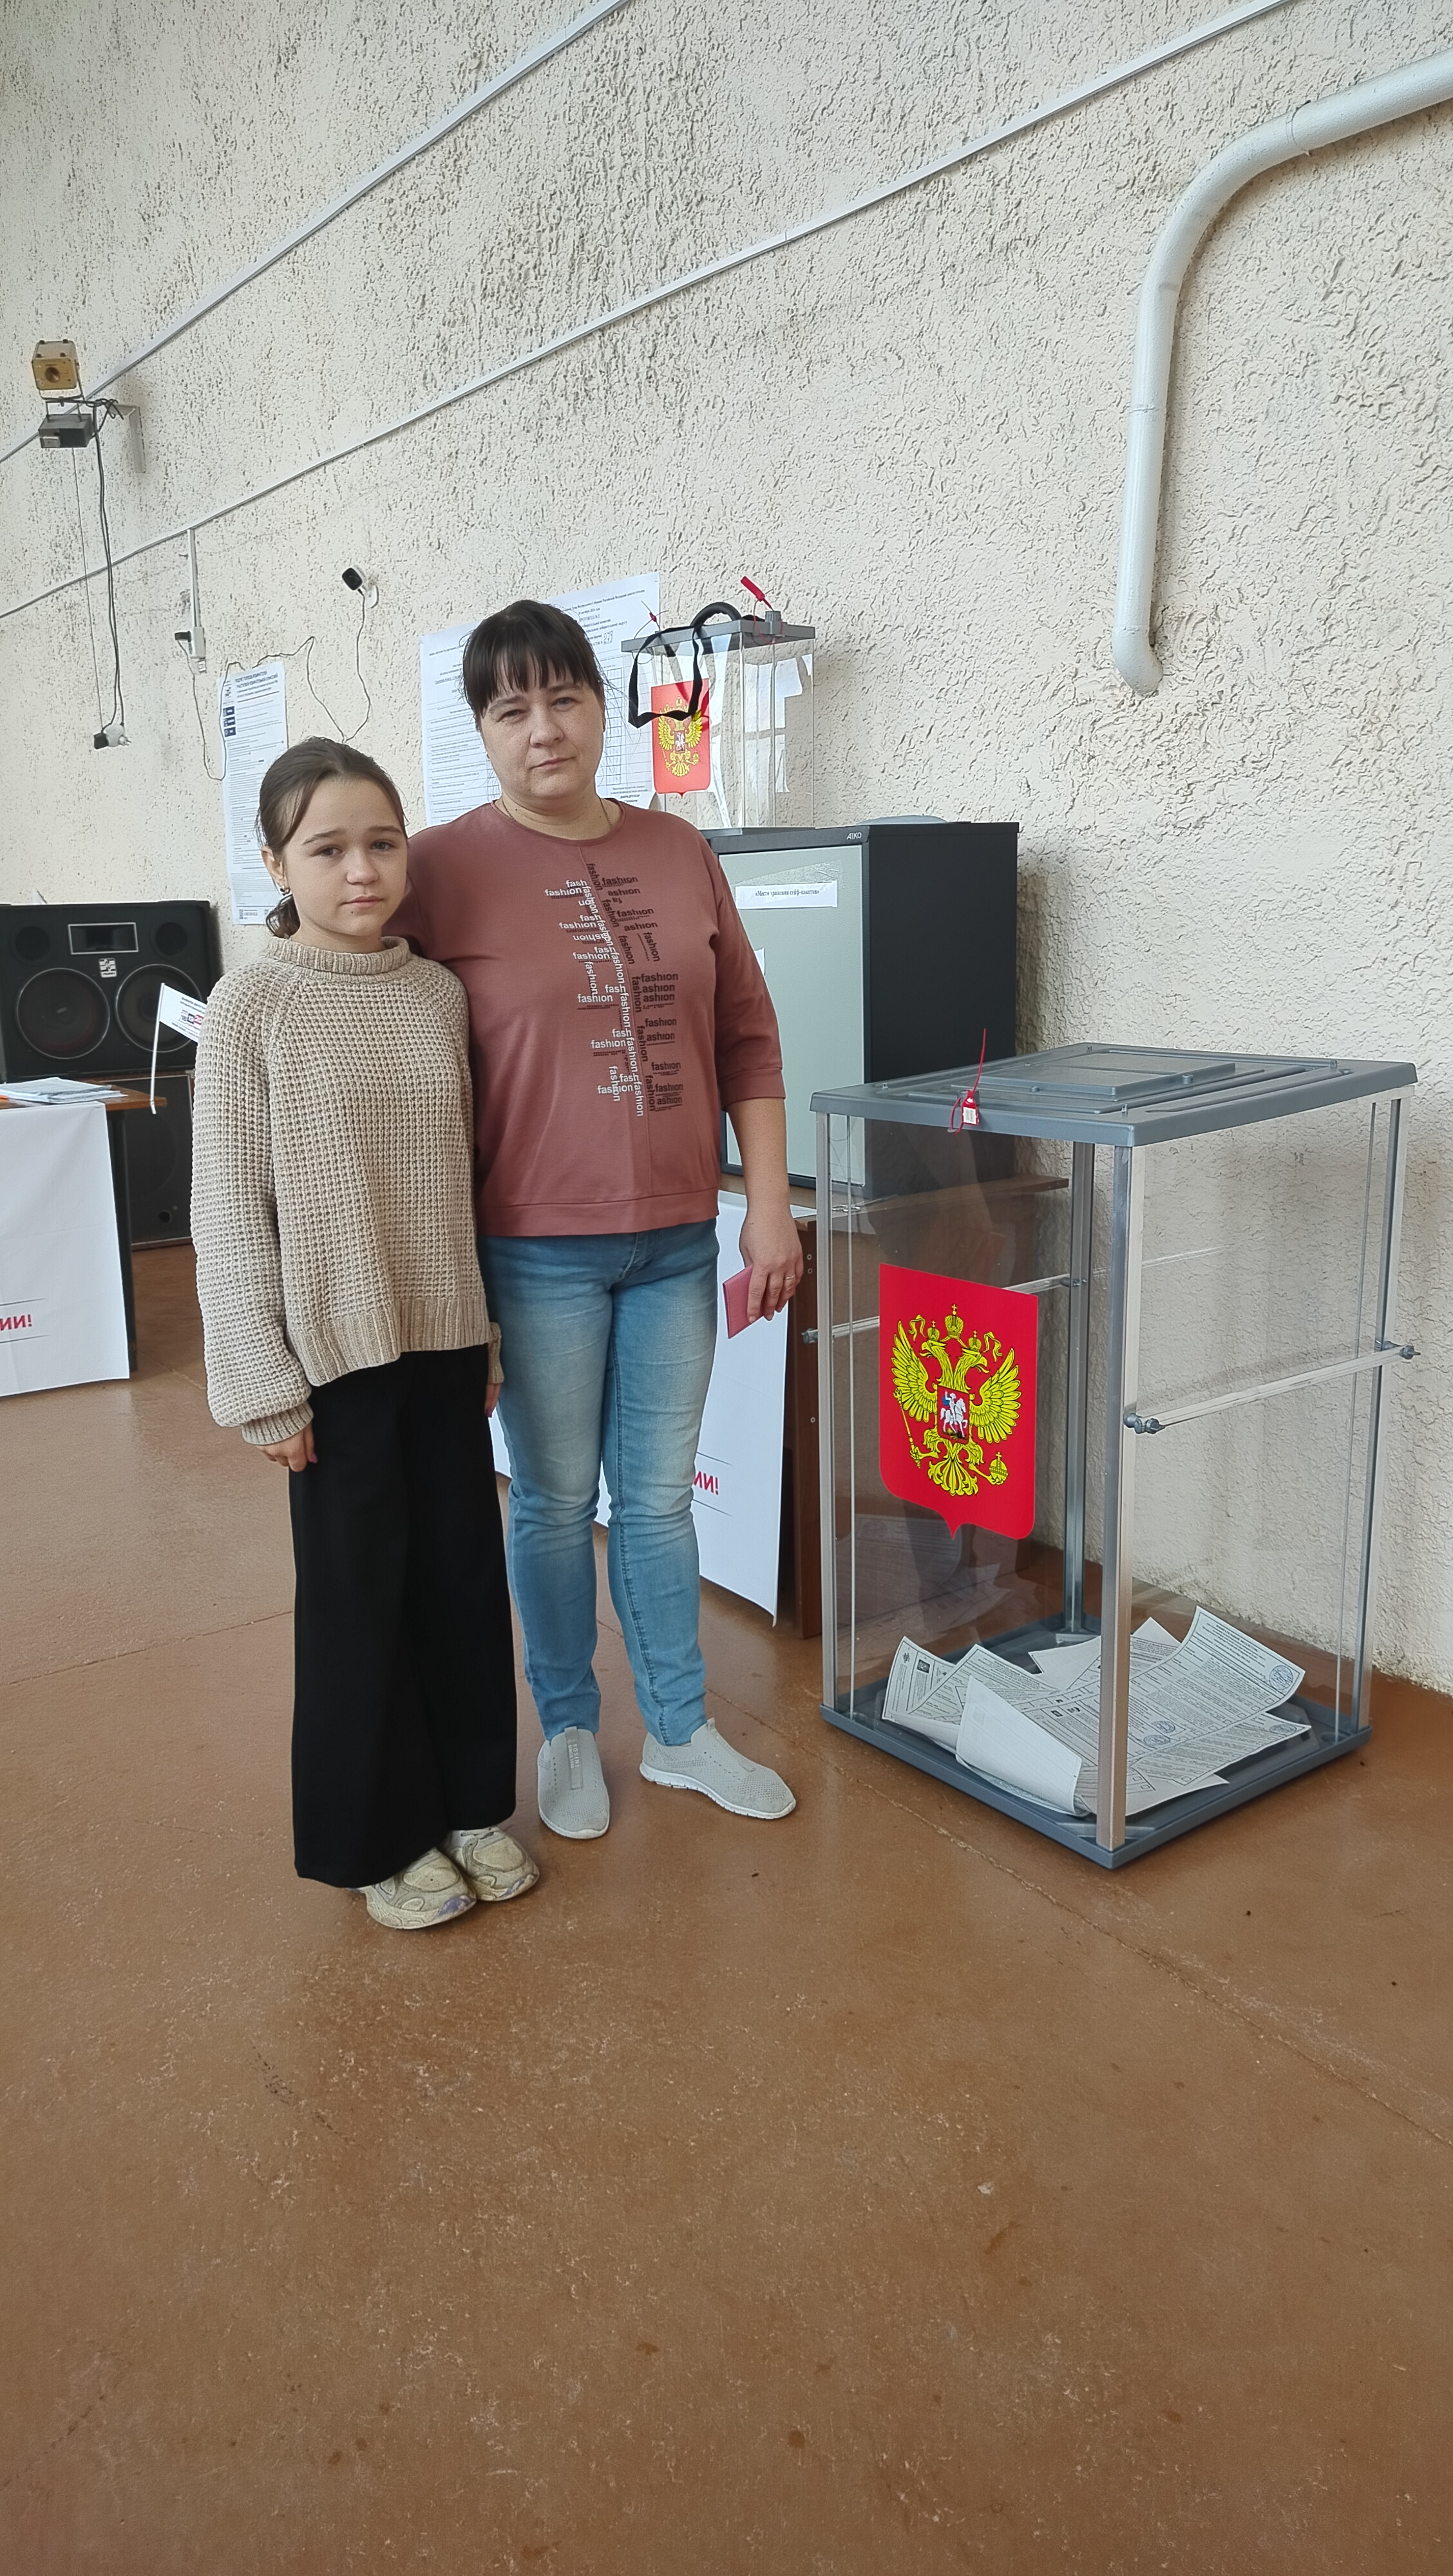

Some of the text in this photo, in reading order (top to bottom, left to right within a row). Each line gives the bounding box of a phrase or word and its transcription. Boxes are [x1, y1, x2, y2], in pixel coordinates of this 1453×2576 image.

[846, 831, 862, 840] AIKO
[587, 863, 603, 891] fashion
[602, 876, 638, 885] fashion
[566, 879, 587, 888] fash
[544, 888, 582, 896] fashion
[607, 887, 641, 896] ashion
[602, 899, 620, 927] fashion
[616, 907, 654, 918] fashion
[623, 922, 658, 931] ashion
[618, 935, 635, 965] fashion
[643, 932, 661, 962] fashion
[610, 952, 625, 984] fashion
[584, 961, 598, 995] fashion
[641, 972, 678, 982] fashion
[605, 984, 625, 993] fash
[642, 983, 675, 992] ashion
[577, 994, 613, 1003] fashion
[632, 976, 642, 1013] fashion
[643, 993, 675, 1002] ashion
[620, 992, 631, 1028] fashion
[645, 1018, 677, 1027] fashion
[612, 1028, 631, 1037] fash
[647, 1032, 675, 1041] ashion
[591, 1039, 626, 1048] fashion
[637, 1025, 649, 1062] fashion
[626, 1037, 638, 1072] fashion
[651, 1061, 681, 1070] fashion
[619, 1074, 639, 1083] fash
[655, 1083, 683, 1092] fashion
[645, 1075, 655, 1111] fashion
[634, 1081, 644, 1116] fashion
[657, 1096, 683, 1104] ashion
